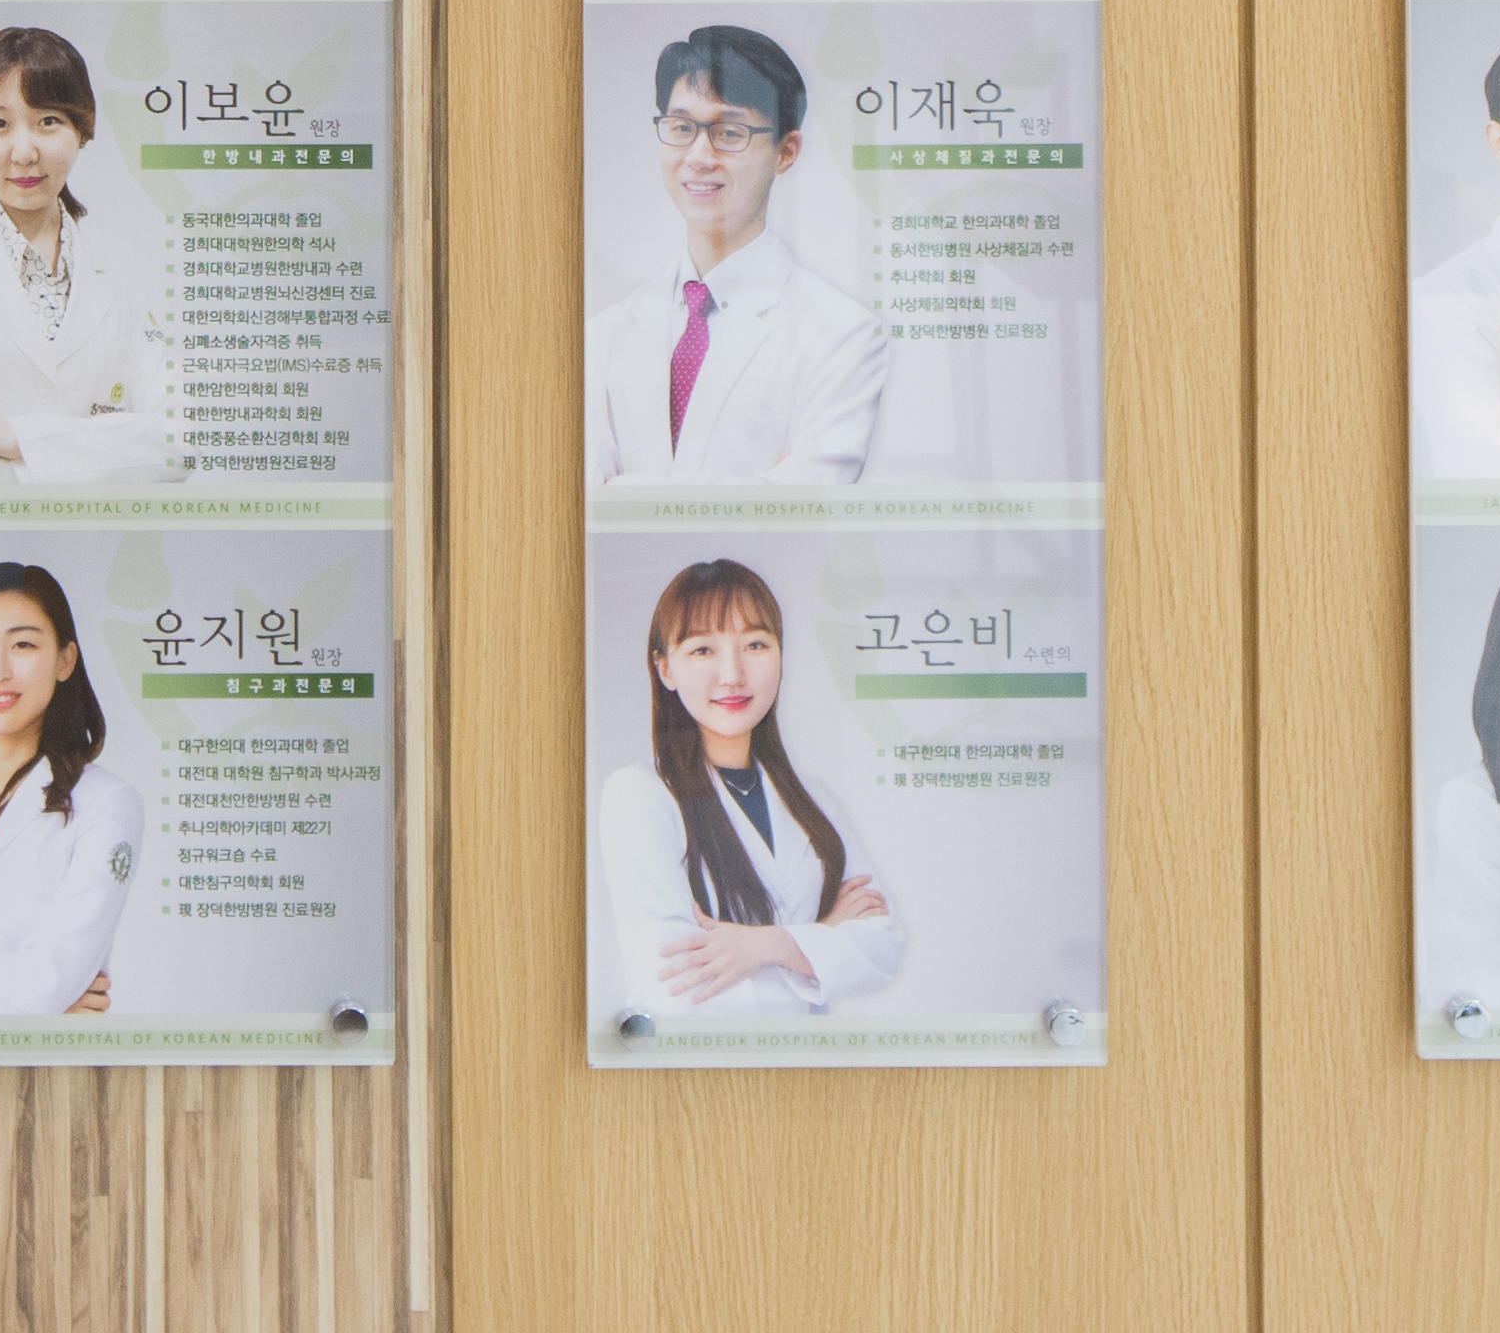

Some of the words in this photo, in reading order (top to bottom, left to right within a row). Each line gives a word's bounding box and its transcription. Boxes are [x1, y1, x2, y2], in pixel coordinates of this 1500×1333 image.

[144, 79, 305, 137] 이보윤
[309, 119, 341, 138] 원장
[854, 78, 1015, 138] 이재욱
[1019, 117, 1051, 136] 원장
[202, 149, 354, 165] 한방내과전문의
[890, 149, 1063, 165] 사상체질과전문의
[142, 608, 303, 667] 윤지원
[310, 647, 343, 667] 원장
[855, 608, 1012, 667] 고은비
[1022, 646, 1071, 665] 수련의
[226, 678, 355, 694] 침구과전문의
